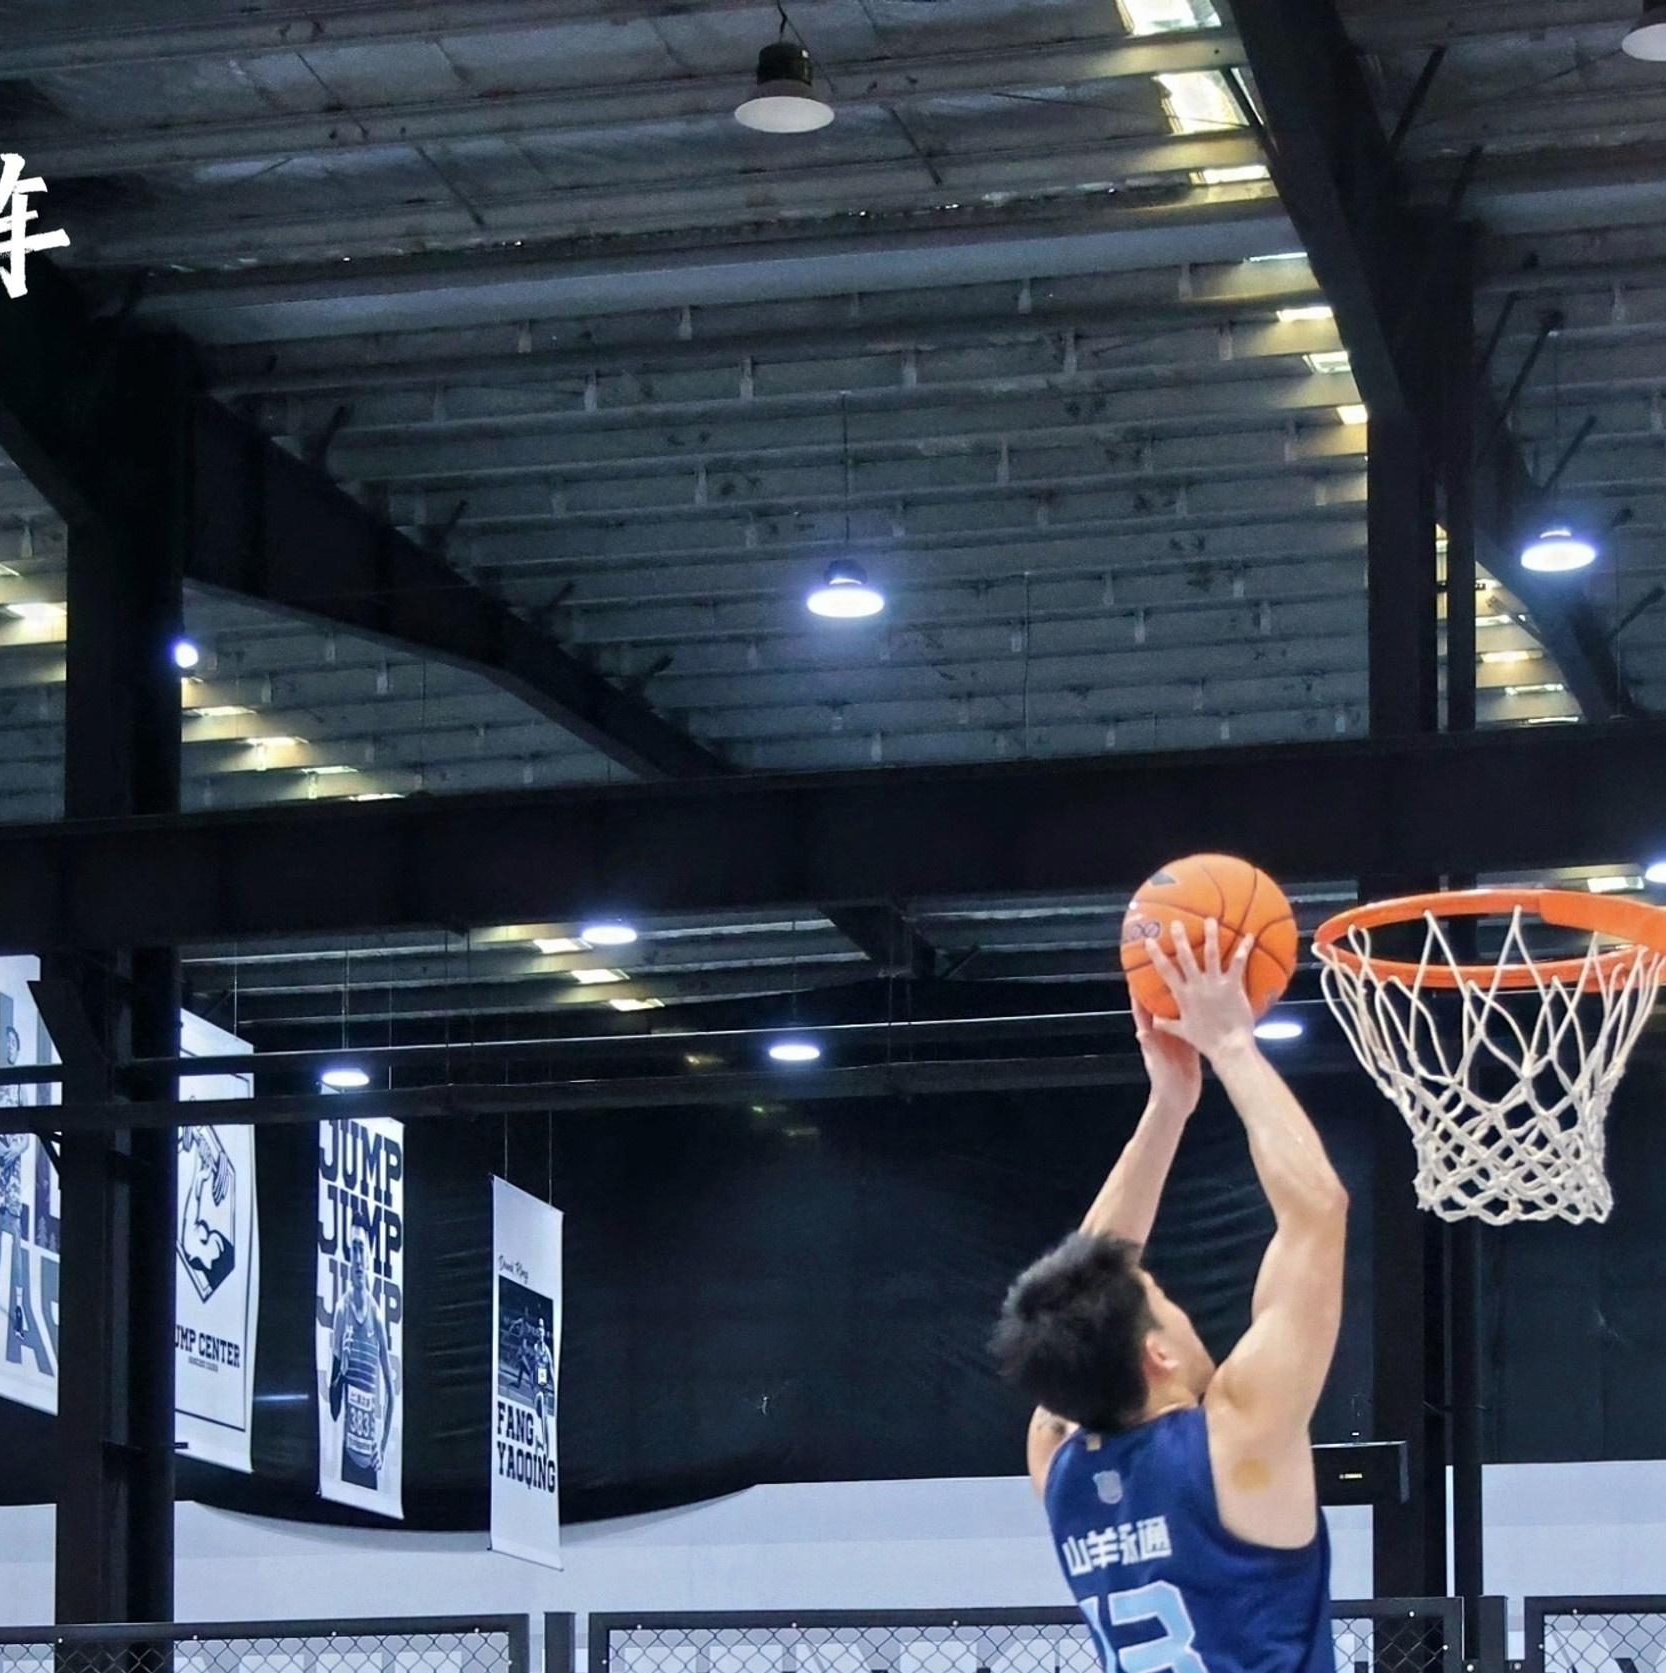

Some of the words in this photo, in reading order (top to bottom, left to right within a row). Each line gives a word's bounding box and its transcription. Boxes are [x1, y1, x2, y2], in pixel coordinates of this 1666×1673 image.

[319, 1118, 403, 1207] JUMP
[198, 1332, 240, 1368] CENTER
[497, 1401, 534, 1446] FANG
[497, 1441, 556, 1494] YAOQING
